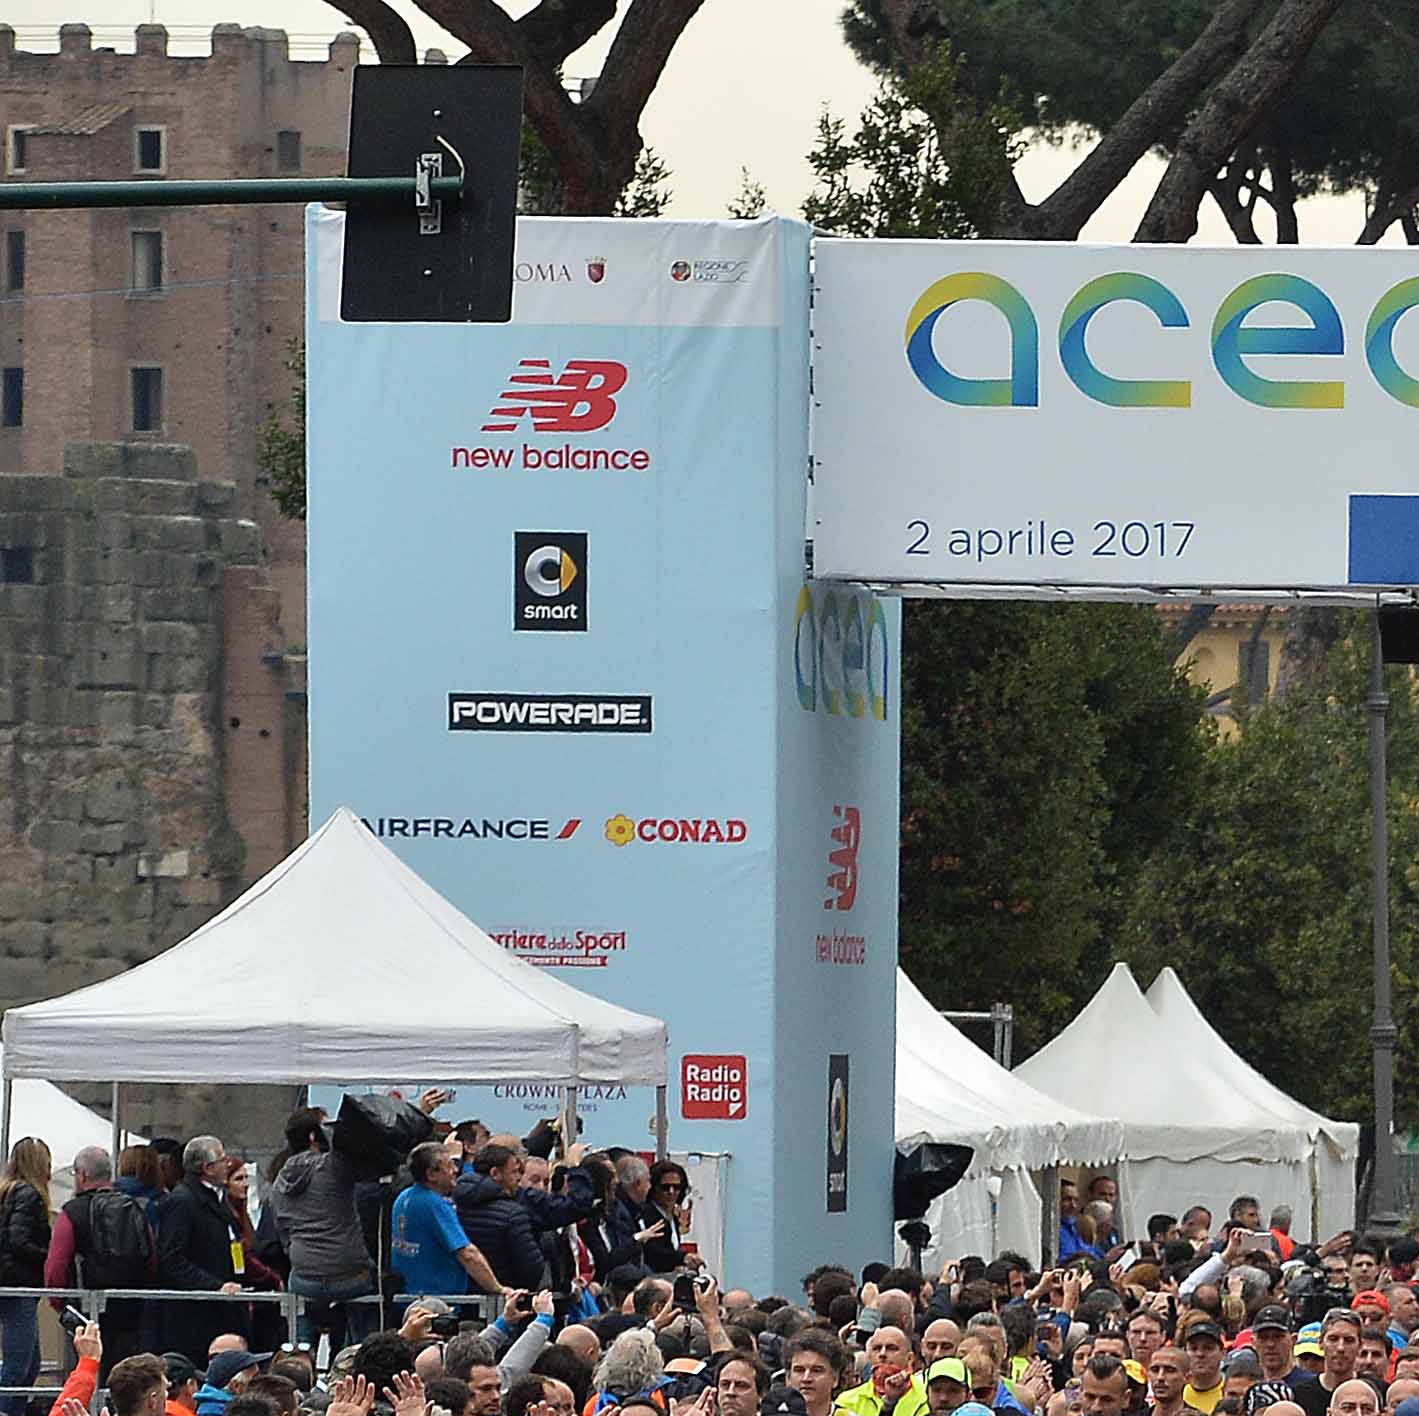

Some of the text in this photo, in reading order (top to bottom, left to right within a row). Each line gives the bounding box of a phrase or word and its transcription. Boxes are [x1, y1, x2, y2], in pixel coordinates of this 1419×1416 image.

[513, 263, 572, 282] OMA
[481, 359, 629, 432] NB
[452, 443, 650, 471] new balance
[906, 518, 1197, 566] 2 aprile 2017
[523, 602, 580, 621] smart
[636, 818, 747, 844] CONAD
[487, 931, 547, 950] rriere
[574, 930, 626, 956] Sport
[686, 1064, 741, 1082] Radio
[494, 1084, 561, 1100] CROWN
[686, 1084, 741, 1102] Radio
